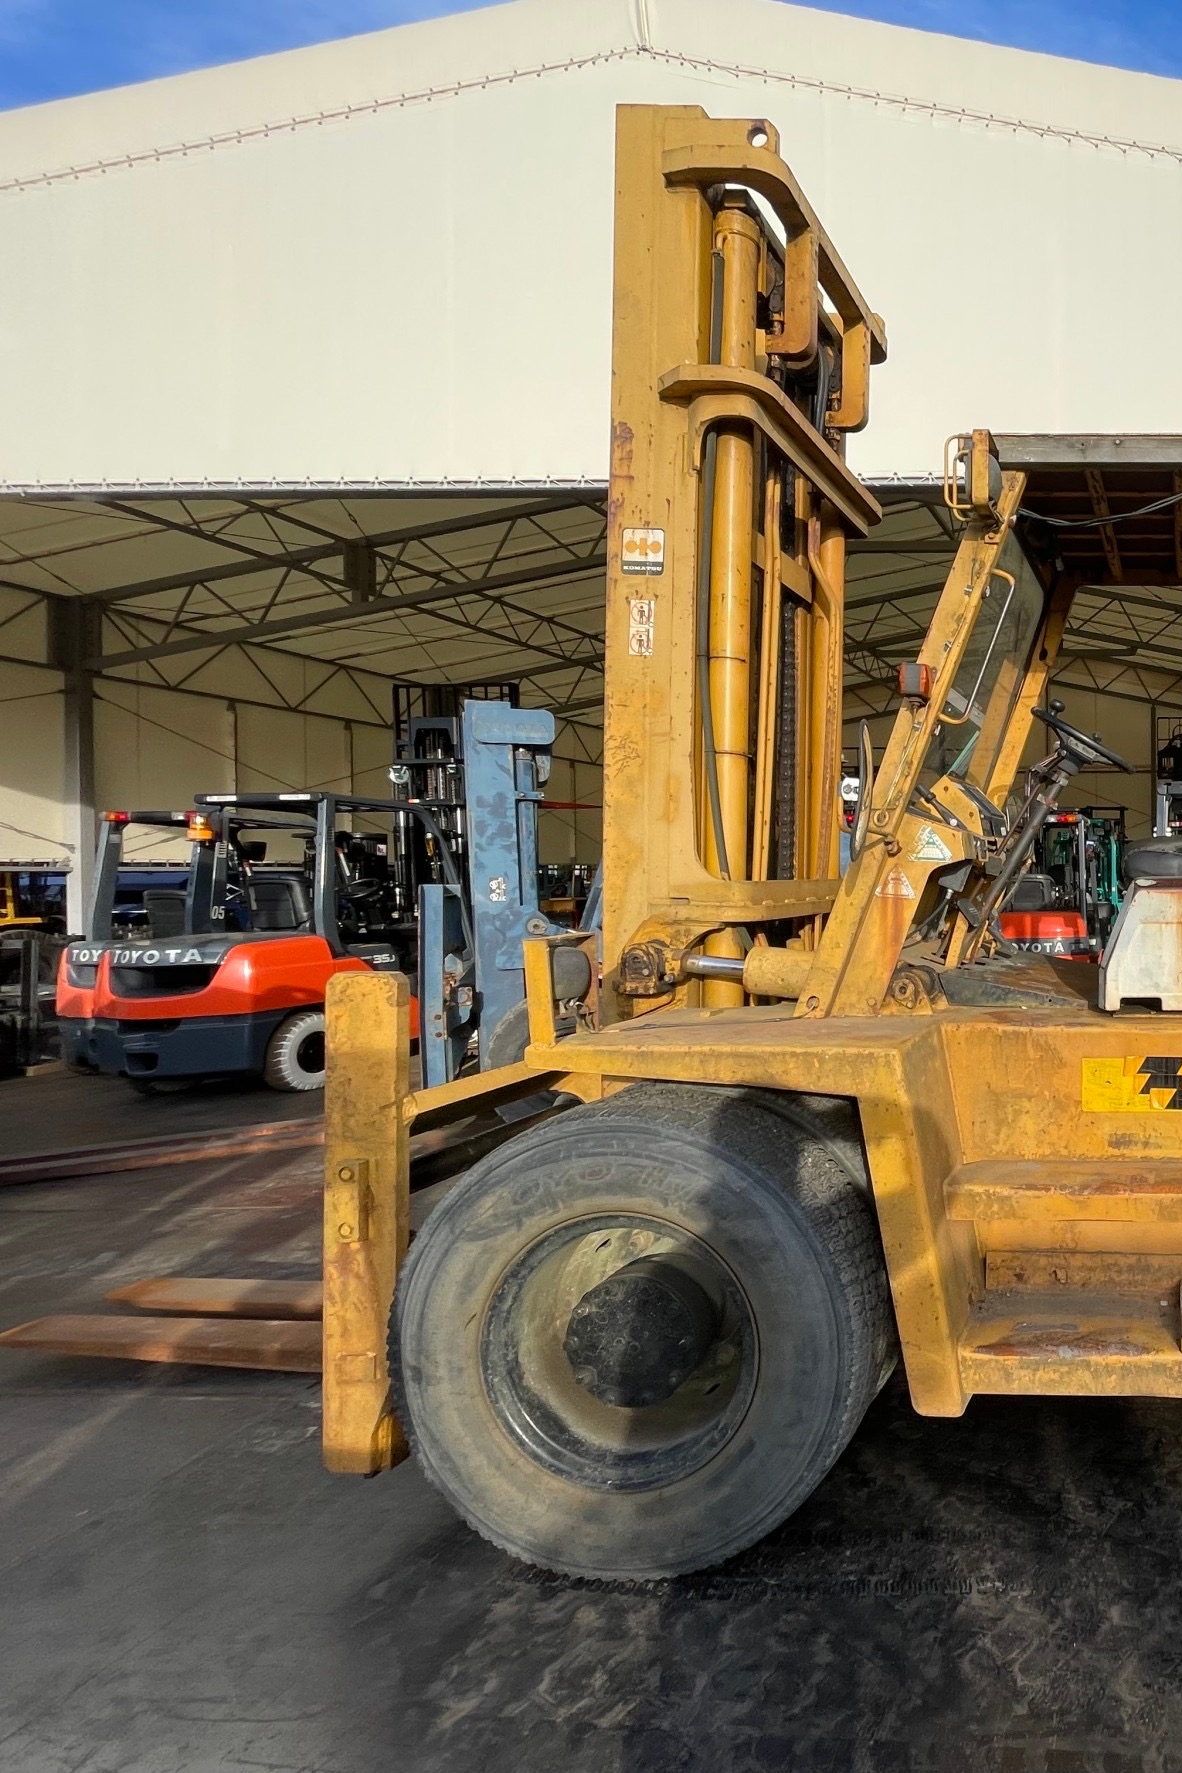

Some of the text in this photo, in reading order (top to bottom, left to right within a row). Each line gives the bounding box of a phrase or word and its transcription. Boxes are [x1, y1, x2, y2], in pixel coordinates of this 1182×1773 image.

[1012, 942, 1065, 953] YOTA
[72, 949, 102, 962] TOY
[113, 948, 203, 965] TOYOTA
